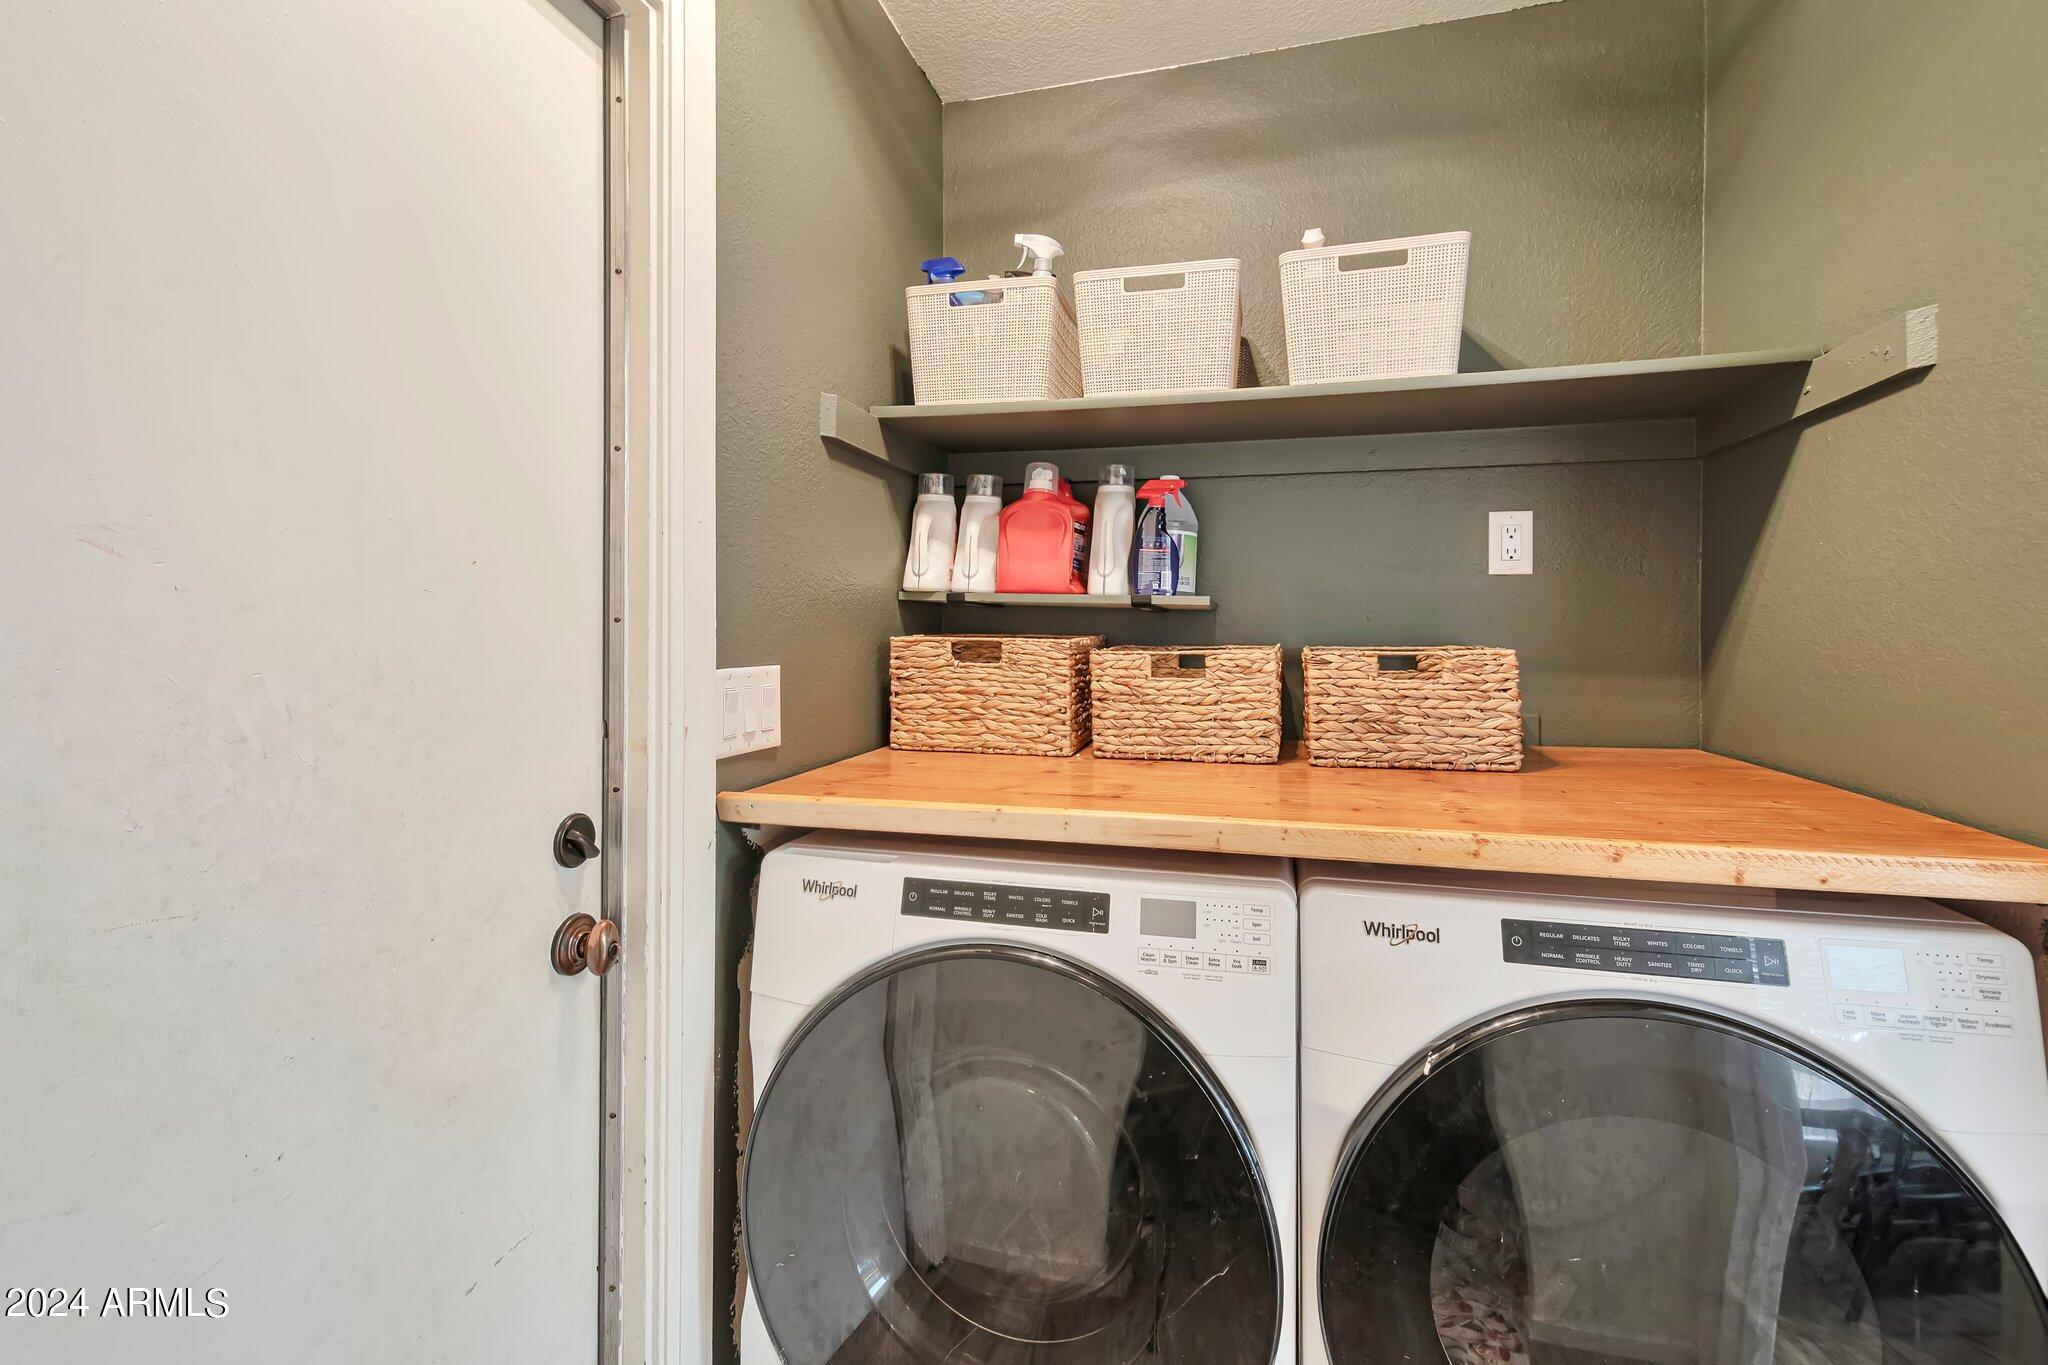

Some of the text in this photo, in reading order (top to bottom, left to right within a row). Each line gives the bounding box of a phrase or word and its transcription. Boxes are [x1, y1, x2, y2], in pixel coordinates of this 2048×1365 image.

[802, 878, 858, 899] Whirlpool
[1363, 920, 1440, 944] Whirlpool
[1572, 934, 1600, 942] DELICATES
[1647, 961, 1673, 969] SANITIZE
[1976, 974, 2001, 982] Dryness
